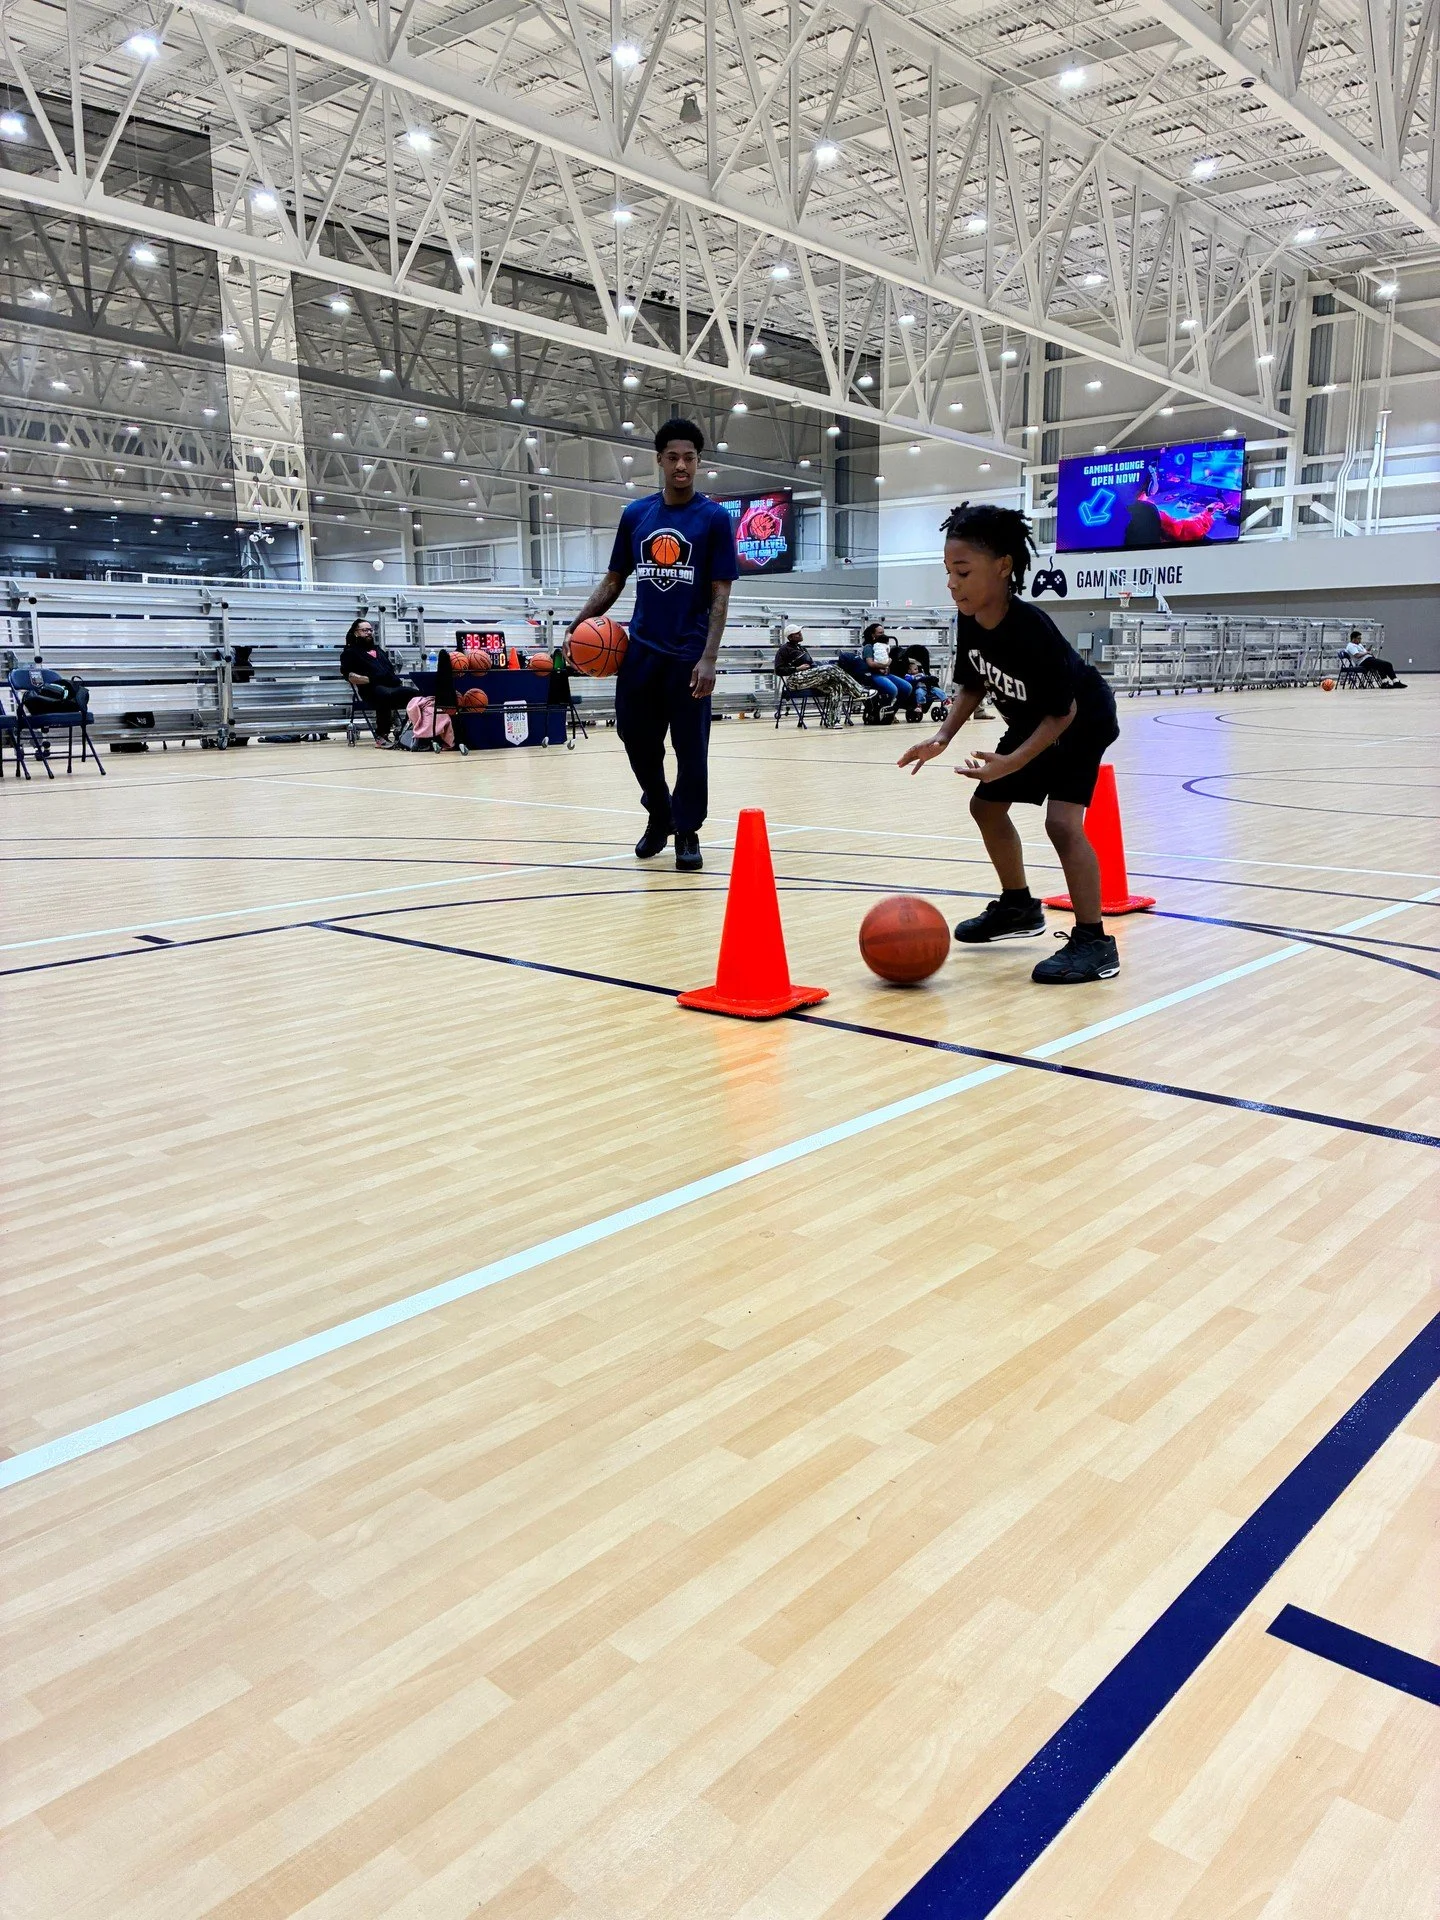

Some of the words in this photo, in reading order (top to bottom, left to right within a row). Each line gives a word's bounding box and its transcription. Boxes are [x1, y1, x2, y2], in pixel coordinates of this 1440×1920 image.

[1083, 462, 1114, 475] GAMING
[1115, 460, 1145, 472] LOUNGE
[1091, 475, 1114, 487] OPEN
[1116, 473, 1140, 485] NOW!
[739, 540, 760, 552] NEXT
[760, 538, 784, 550] LEVEL
[637, 567, 655, 576] NEXT
[656, 567, 678, 578] LEVEL
[678, 569, 693, 580] 901
[466, 633, 500, 648] 35:36
